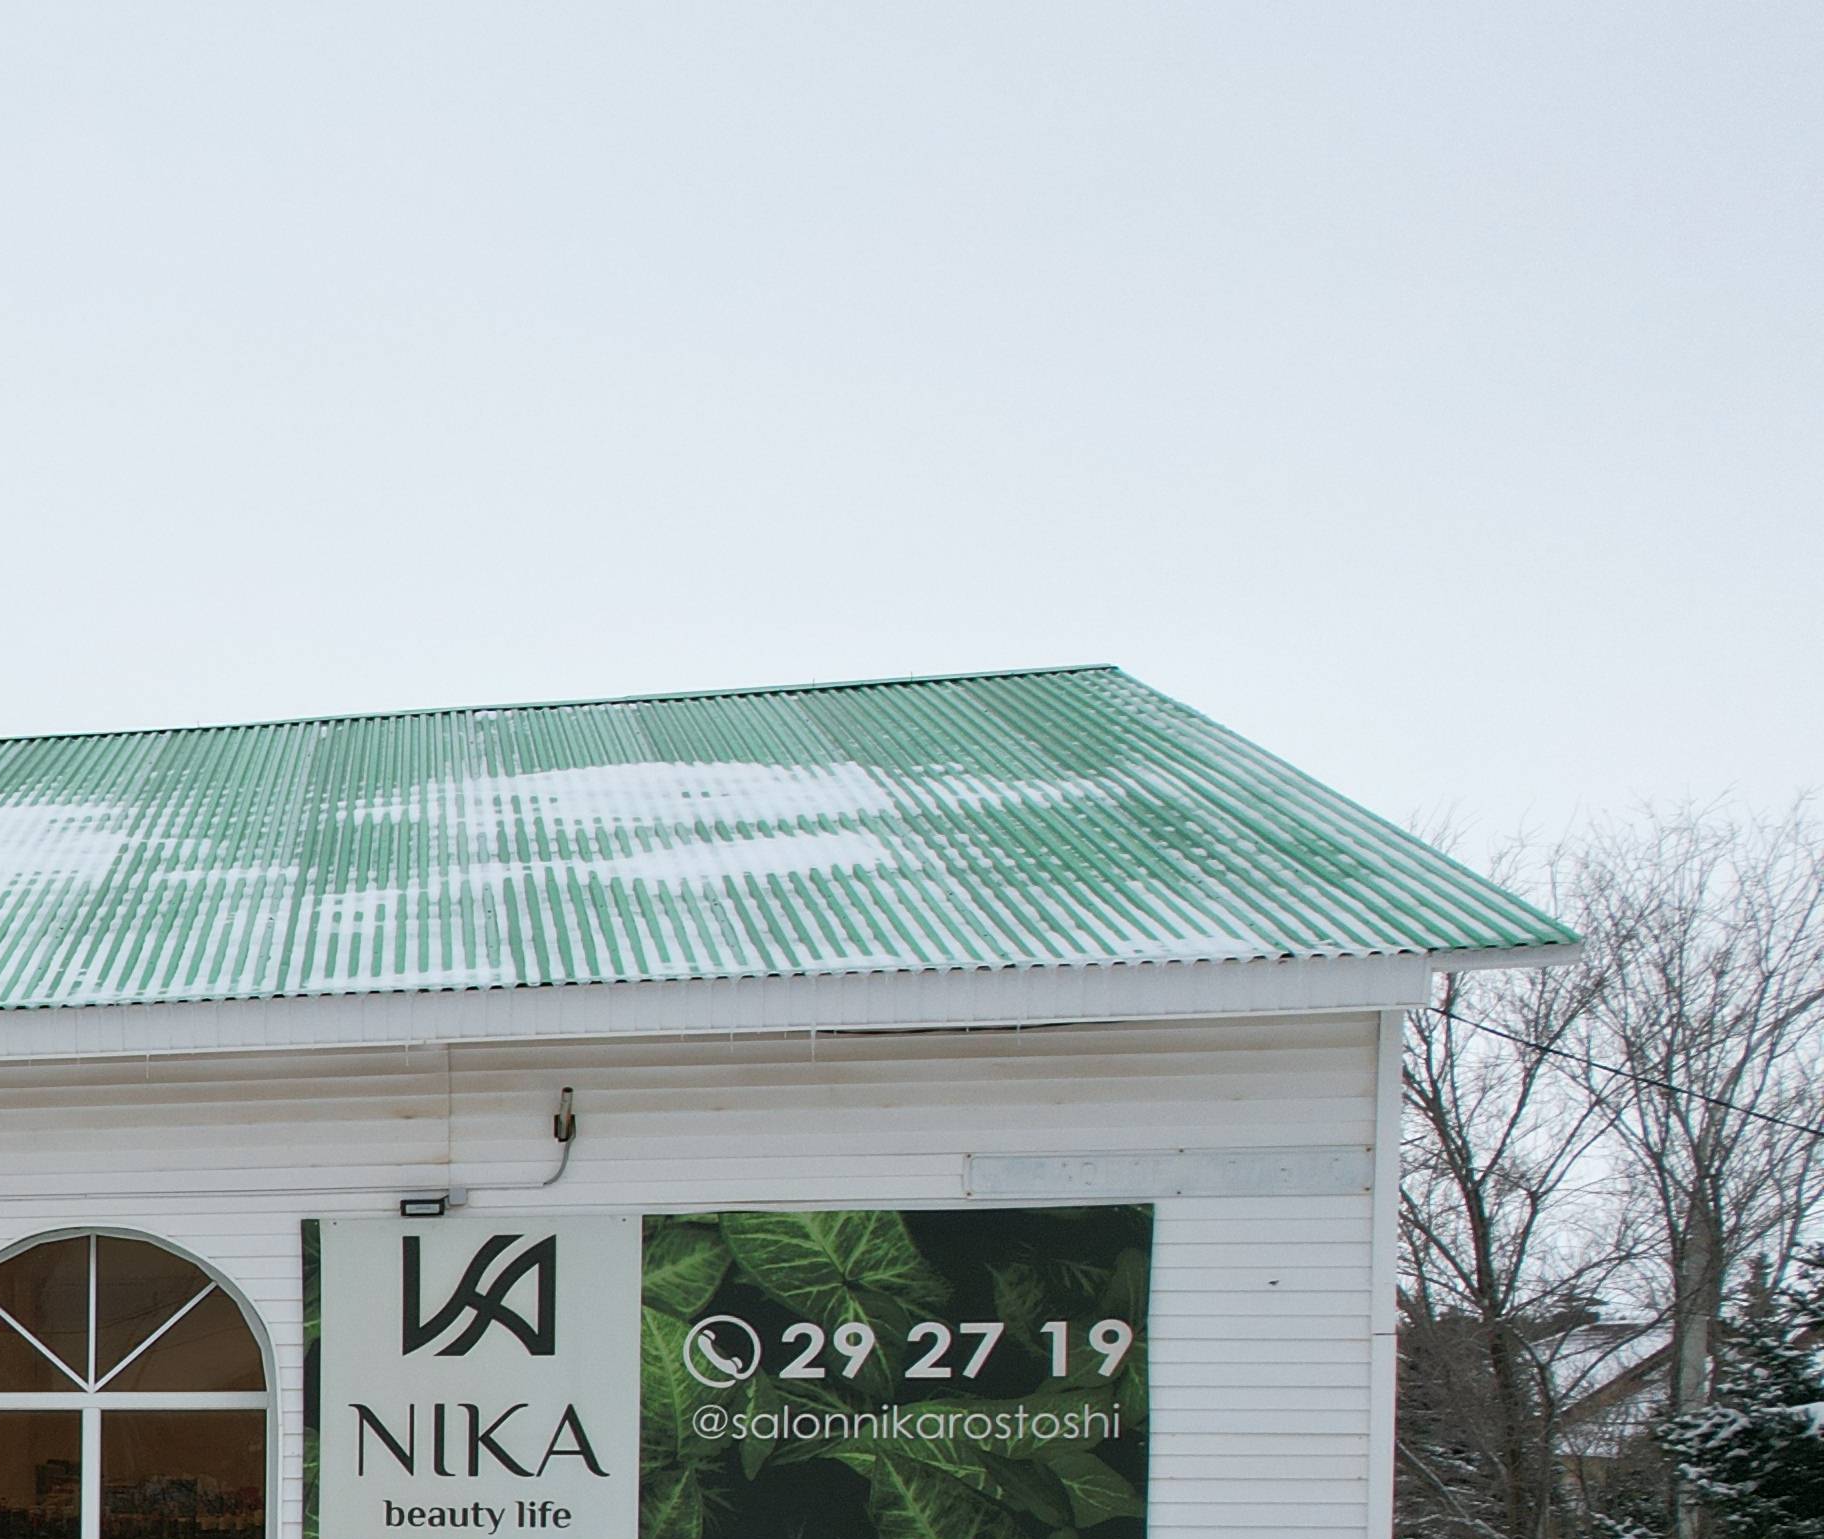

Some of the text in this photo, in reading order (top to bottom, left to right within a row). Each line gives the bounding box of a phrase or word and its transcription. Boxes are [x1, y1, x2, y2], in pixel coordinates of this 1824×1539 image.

[778, 1319, 1133, 1379] 29 27 19
[348, 1403, 611, 1477] NIKA
[692, 1403, 1121, 1440] @salonnikarostoshi
[382, 1500, 572, 1535] beauty life
